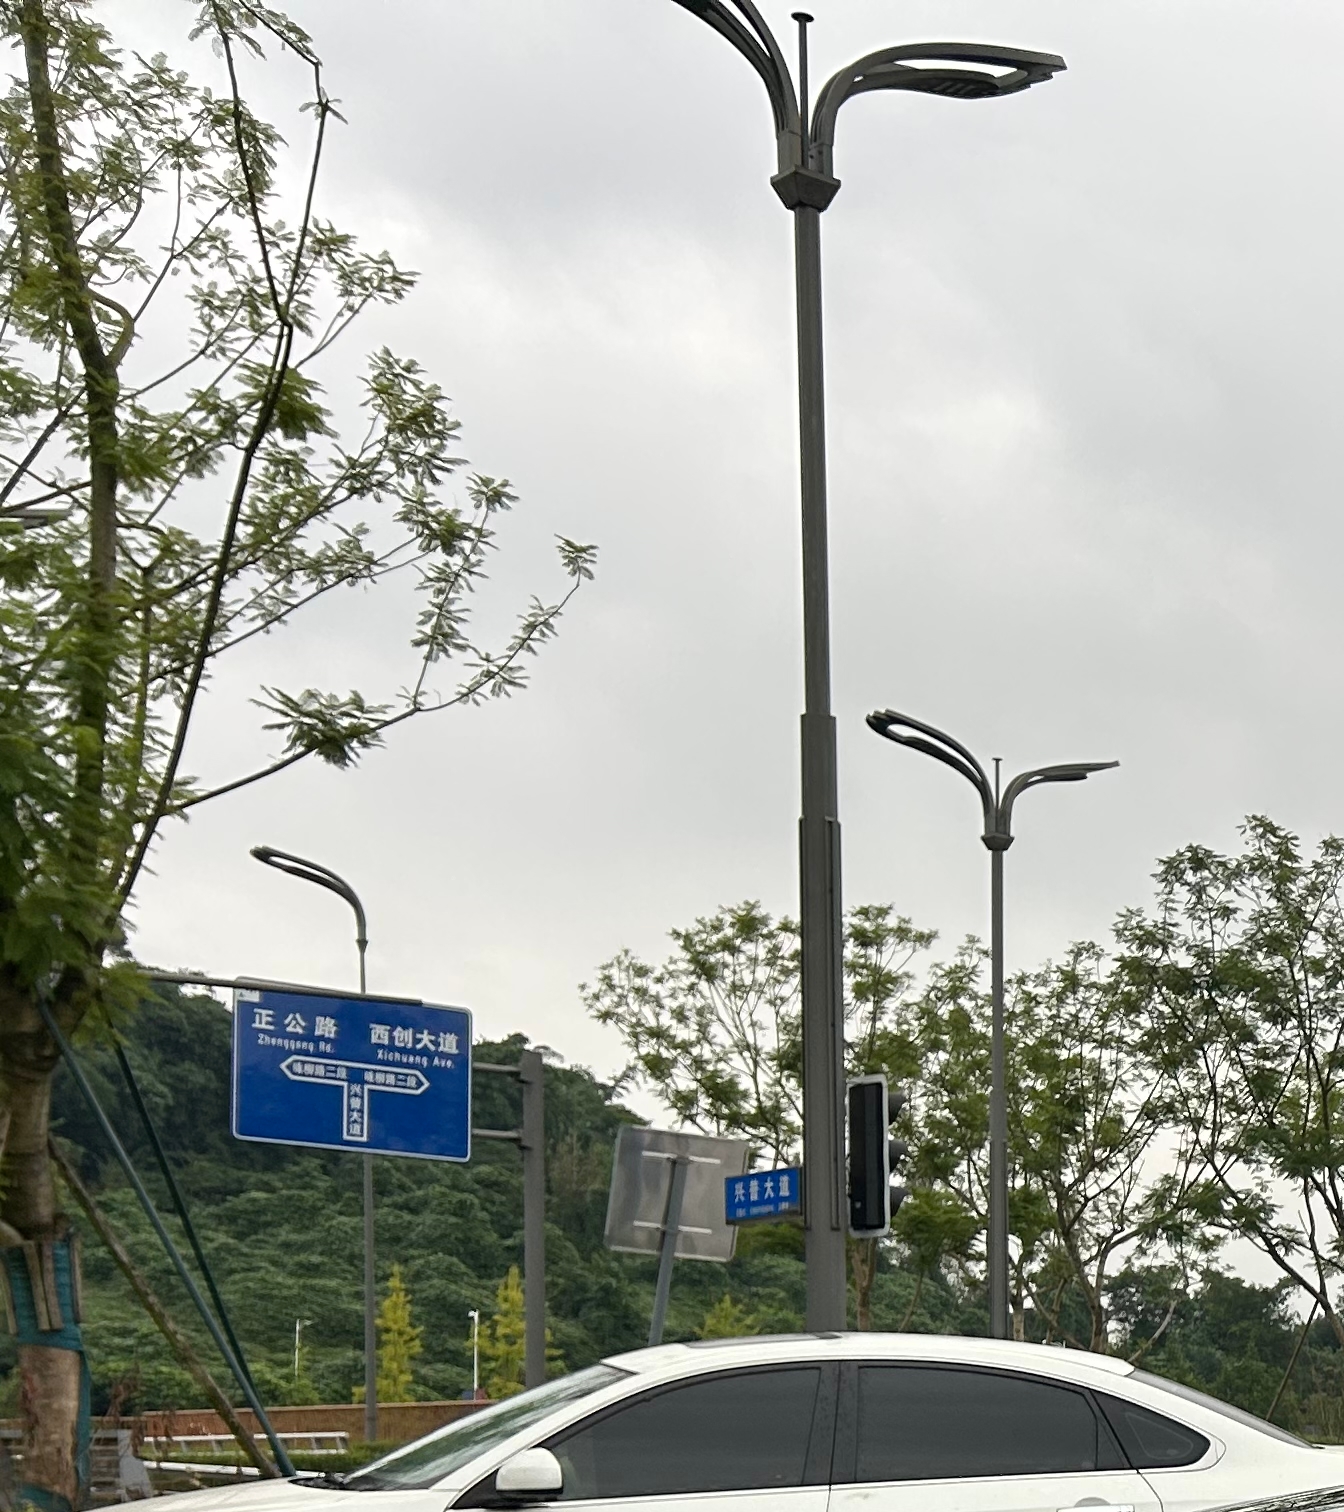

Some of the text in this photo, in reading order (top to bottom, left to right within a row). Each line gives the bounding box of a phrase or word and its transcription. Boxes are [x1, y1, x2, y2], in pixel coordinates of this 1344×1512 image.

[251, 1008, 339, 1039] 正公路
[369, 1023, 460, 1054] 西创大道
